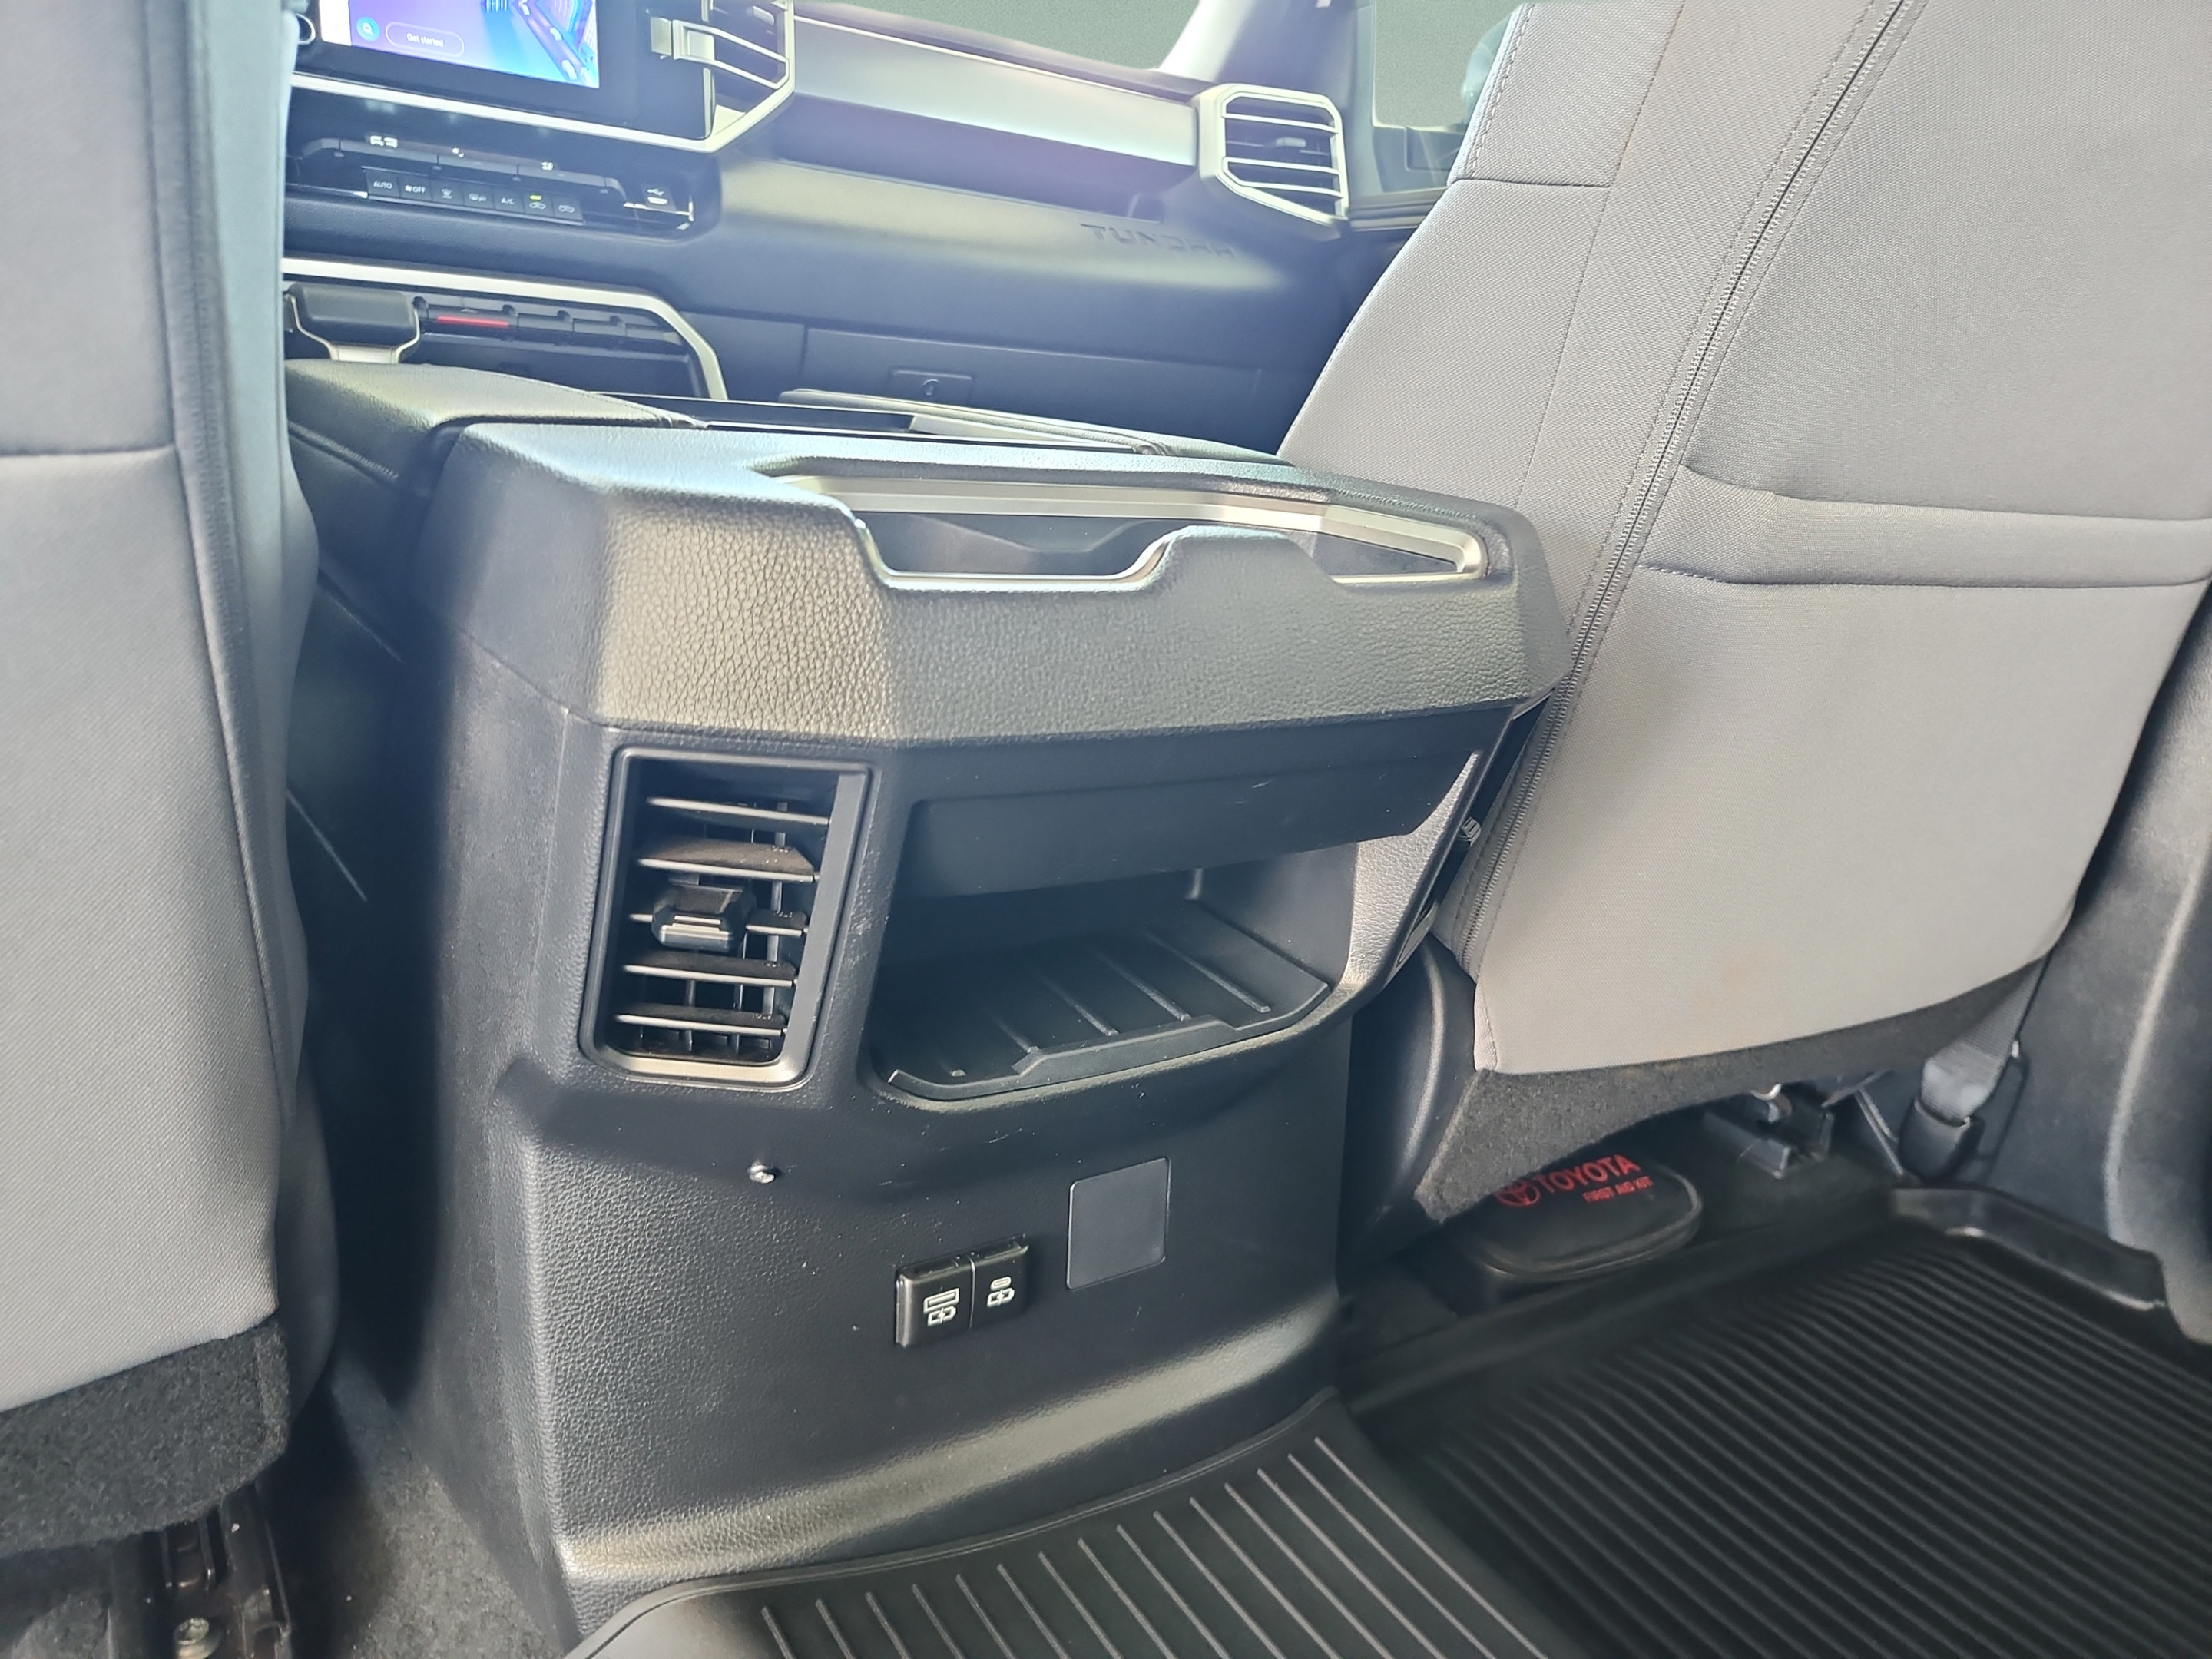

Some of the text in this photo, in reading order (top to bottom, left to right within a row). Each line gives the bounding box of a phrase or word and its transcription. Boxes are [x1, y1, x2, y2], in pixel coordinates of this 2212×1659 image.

[373, 180, 392, 190] AUTO
[1080, 224, 1237, 259] TUNDRA
[1532, 1154, 1641, 1194] TOYOTA
